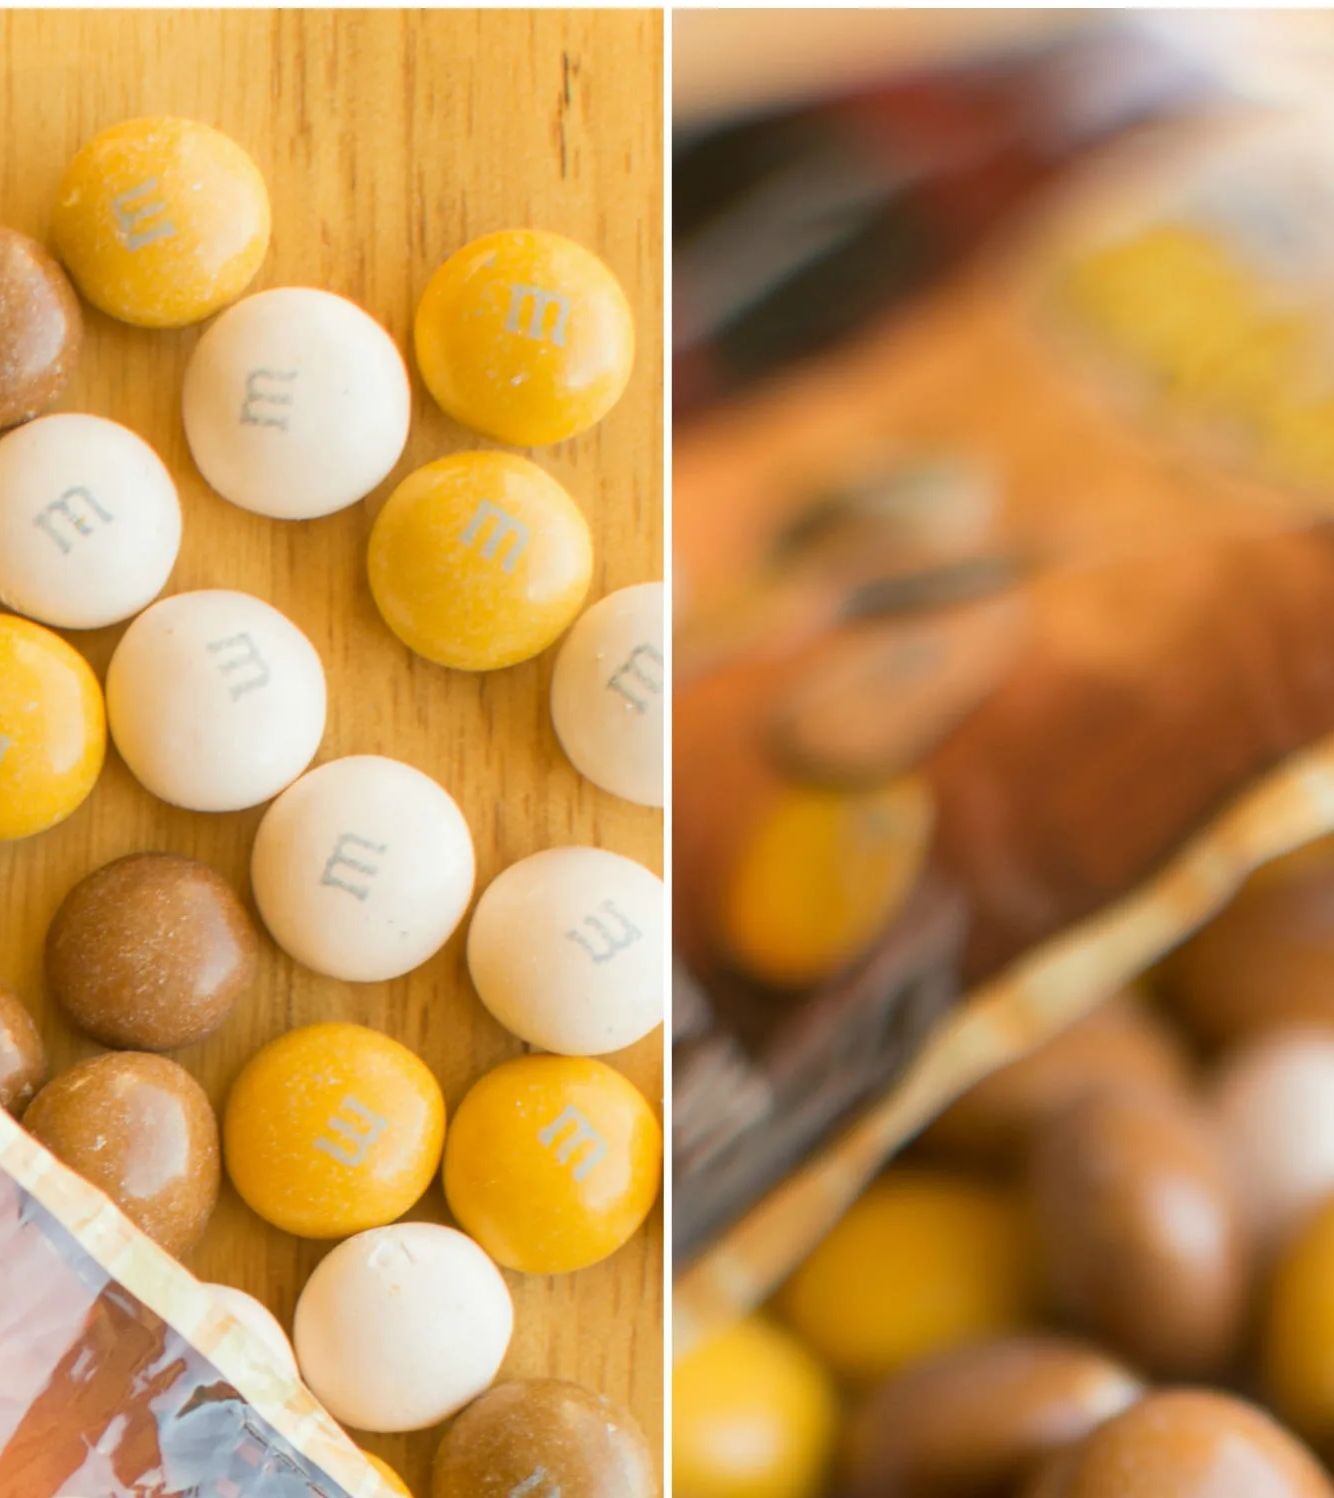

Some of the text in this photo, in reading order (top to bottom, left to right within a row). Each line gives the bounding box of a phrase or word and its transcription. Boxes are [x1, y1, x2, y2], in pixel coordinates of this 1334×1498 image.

[111, 175, 173, 251] m
[505, 281, 573, 347] m
[240, 366, 297, 431] m
[34, 483, 114, 551] m
[460, 500, 531, 572] m
[206, 631, 271, 701] m
[321, 830, 387, 901] m
[565, 899, 642, 964] m
[314, 1094, 387, 1169] m
[536, 1104, 607, 1181] m
